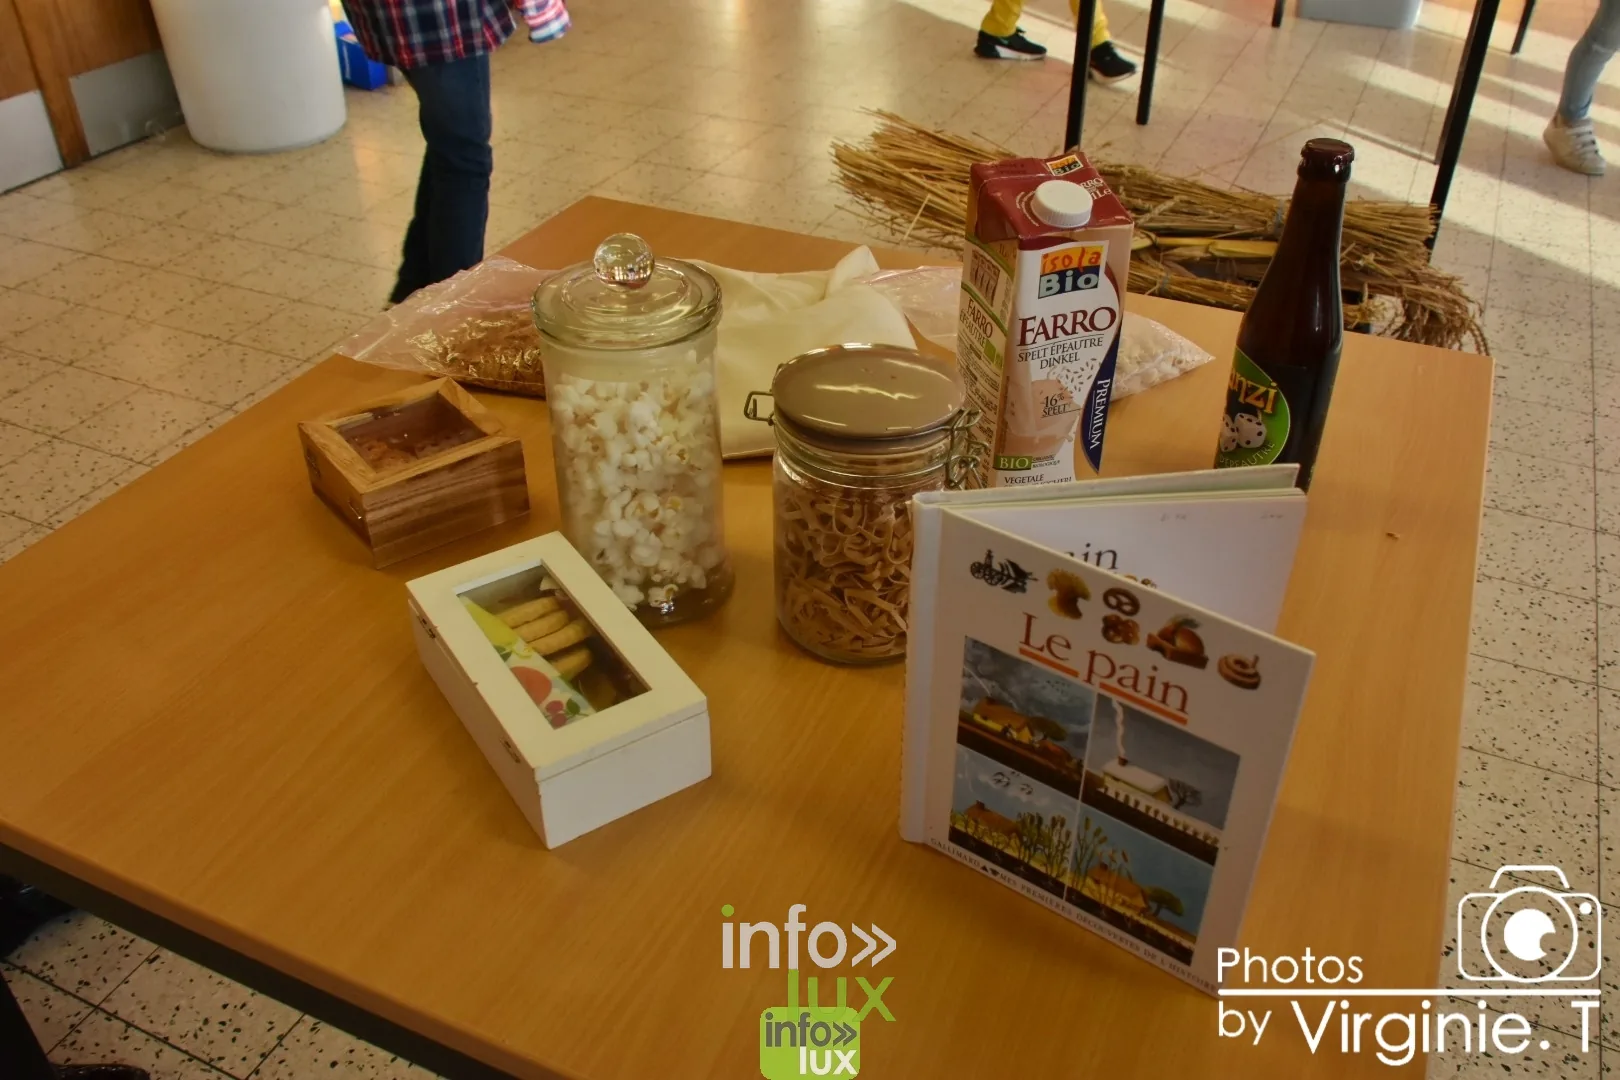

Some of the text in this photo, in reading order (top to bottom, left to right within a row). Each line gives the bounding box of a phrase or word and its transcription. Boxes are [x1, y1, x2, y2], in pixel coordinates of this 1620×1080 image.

[1080, 177, 1104, 188] RRO
[1041, 246, 1102, 273] isola
[1039, 269, 1099, 297] Bio
[967, 297, 993, 339] FARRO
[1016, 306, 1117, 347] FARRO
[1018, 347, 1049, 363] SPELT
[1040, 351, 1080, 370] DINKEL
[1089, 378, 1111, 450] PREMIUM
[1000, 457, 1029, 469] BIO
[1004, 473, 1044, 485] VEGETALE
[1020, 612, 1190, 715] Le pain
[930, 838, 980, 867] GALLIMARD
[999, 872, 1018, 887] MES
[1144, 948, 1157, 961] DE
